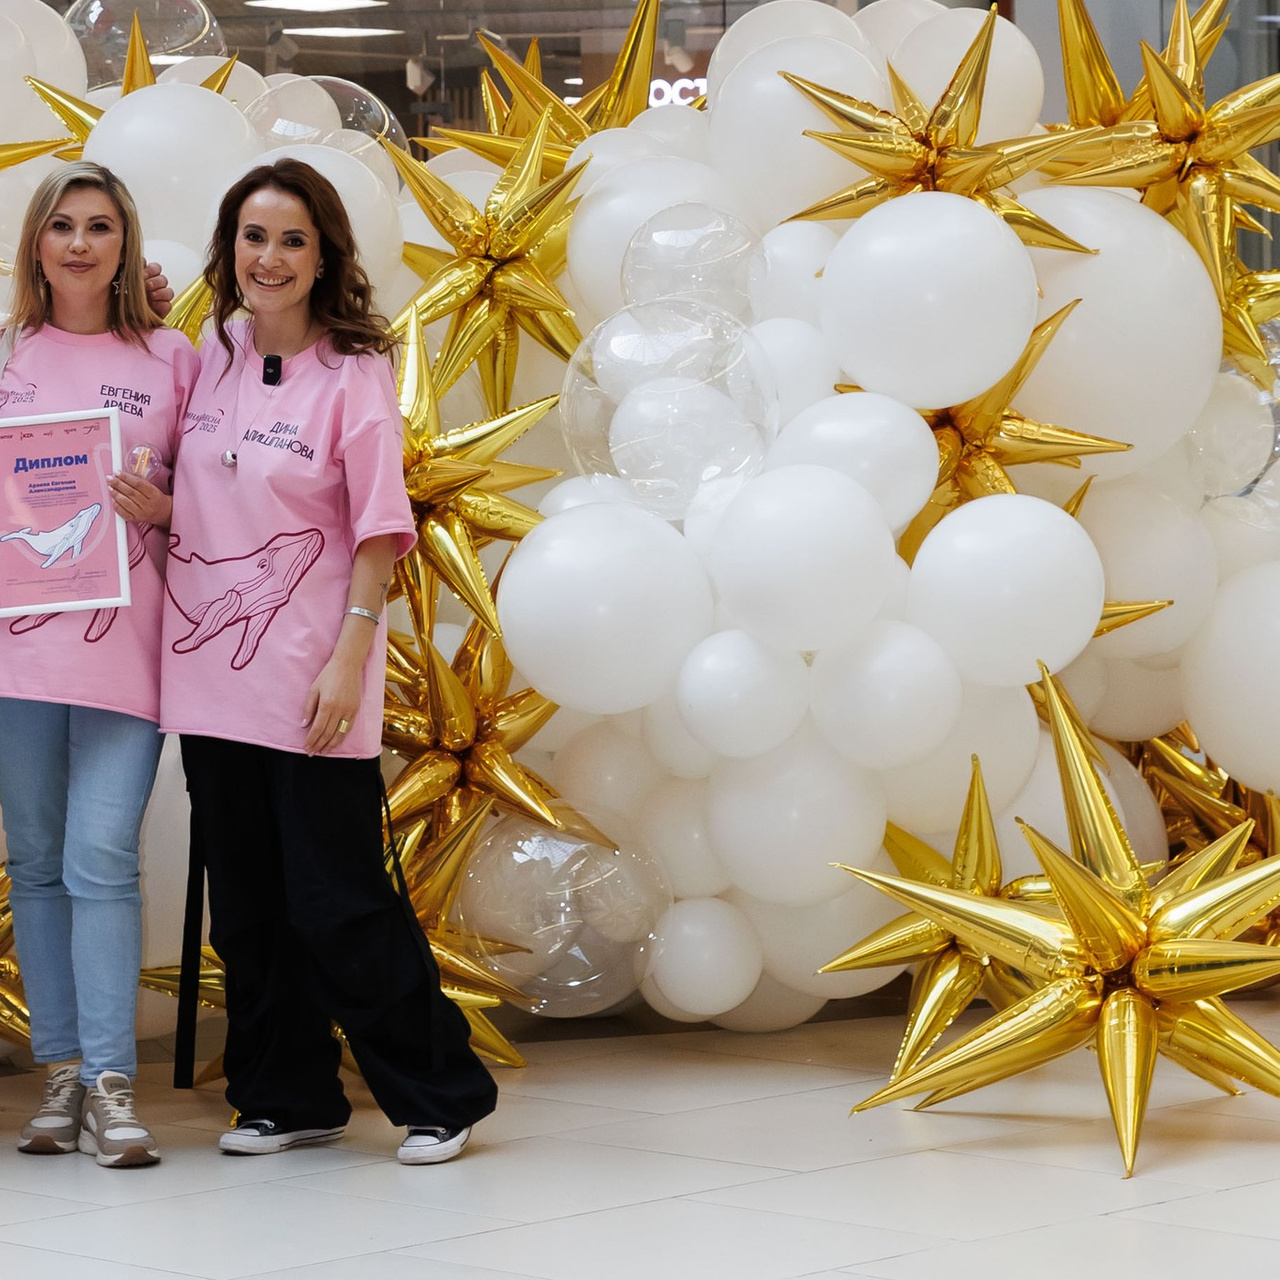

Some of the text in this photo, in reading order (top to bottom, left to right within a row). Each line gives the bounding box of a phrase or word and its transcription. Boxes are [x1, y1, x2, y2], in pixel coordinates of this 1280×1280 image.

[12, 396, 35, 404] 2025
[100, 385, 151, 406] ЕВГЕНИЯ
[103, 399, 144, 418] АРАЕВА
[199, 422, 218, 433] 2025
[270, 421, 299, 436] ДИНА
[13, 454, 88, 473] Диплом
